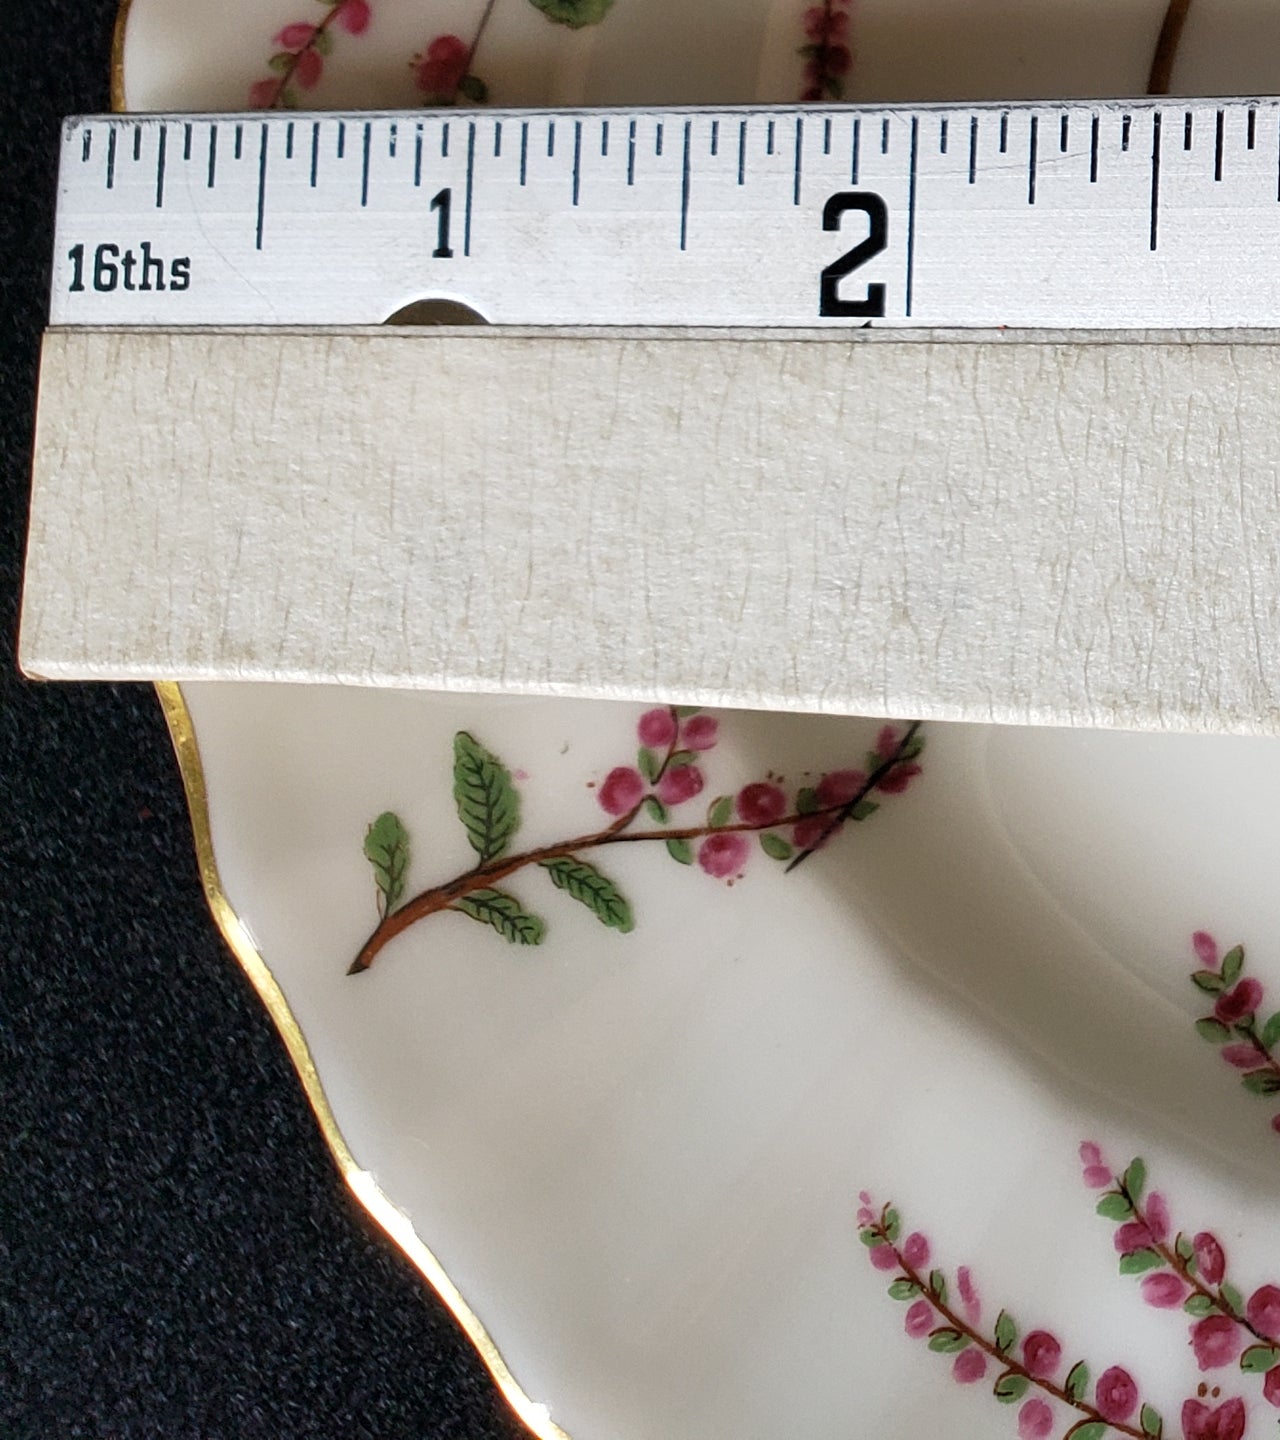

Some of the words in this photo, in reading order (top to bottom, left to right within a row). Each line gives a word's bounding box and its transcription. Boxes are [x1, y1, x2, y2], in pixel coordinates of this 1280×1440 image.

[67, 241, 191, 292] 16ths
[430, 187, 454, 259] 1
[819, 191, 889, 318] 2
